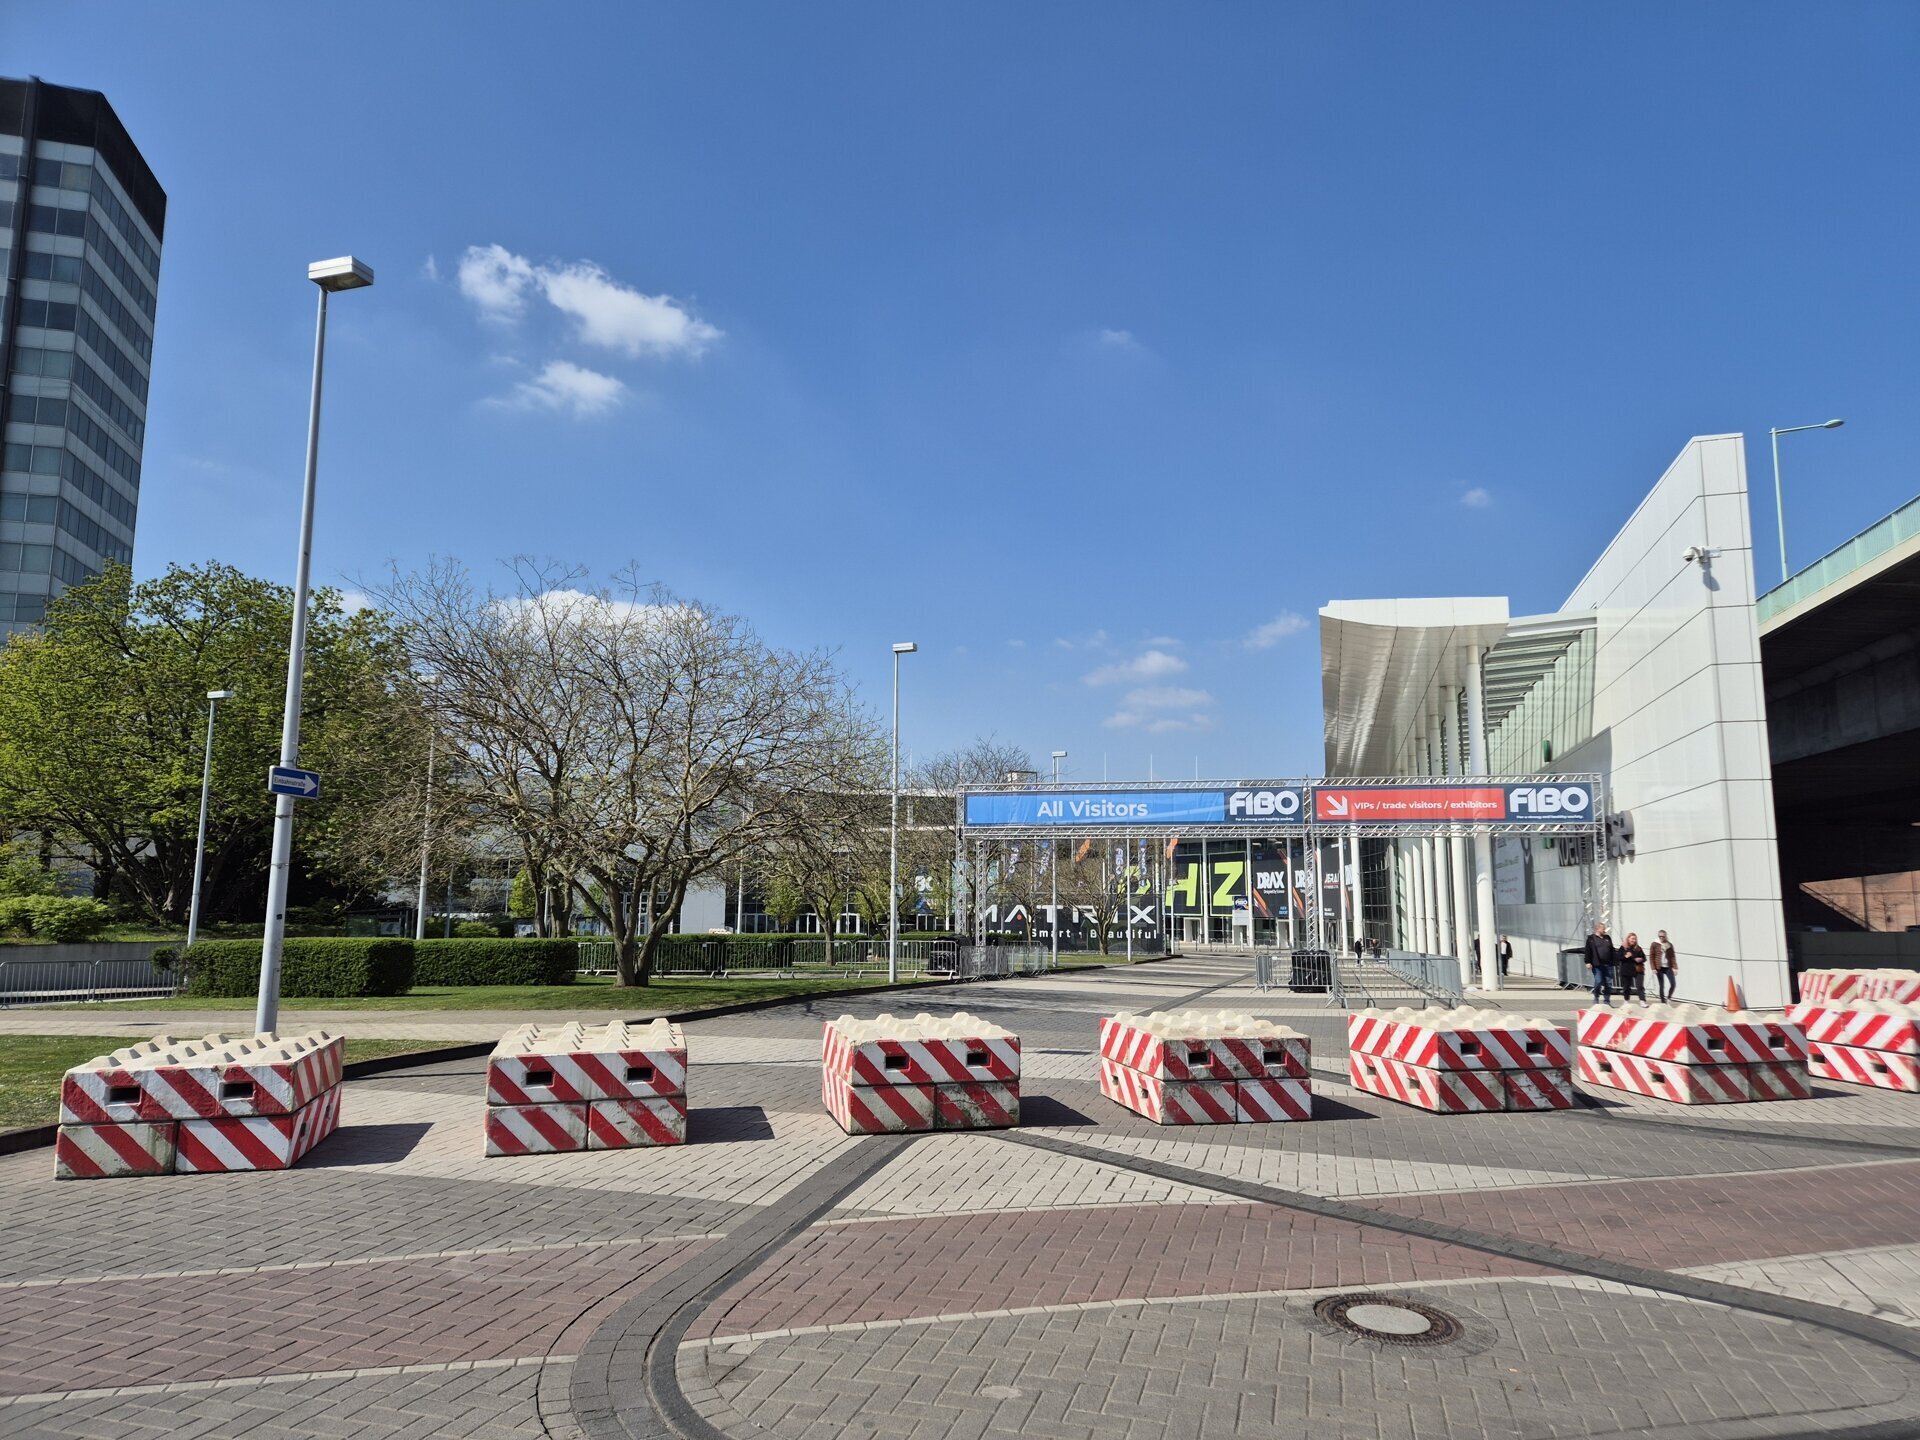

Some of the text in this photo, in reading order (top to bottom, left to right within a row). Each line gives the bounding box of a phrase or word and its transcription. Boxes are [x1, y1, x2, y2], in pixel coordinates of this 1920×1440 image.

[1037, 799, 1149, 817] All Visitors
[1229, 790, 1300, 816] FIBO
[1354, 801, 1375, 809] VIPs
[1382, 801, 1407, 809] trade
[1409, 800, 1442, 809] visitors
[1450, 800, 1498, 809] exhibitors
[1509, 786, 1589, 813] FIBO
[1256, 871, 1285, 889] DRAX
[1090, 929, 1157, 939] Bautiful
